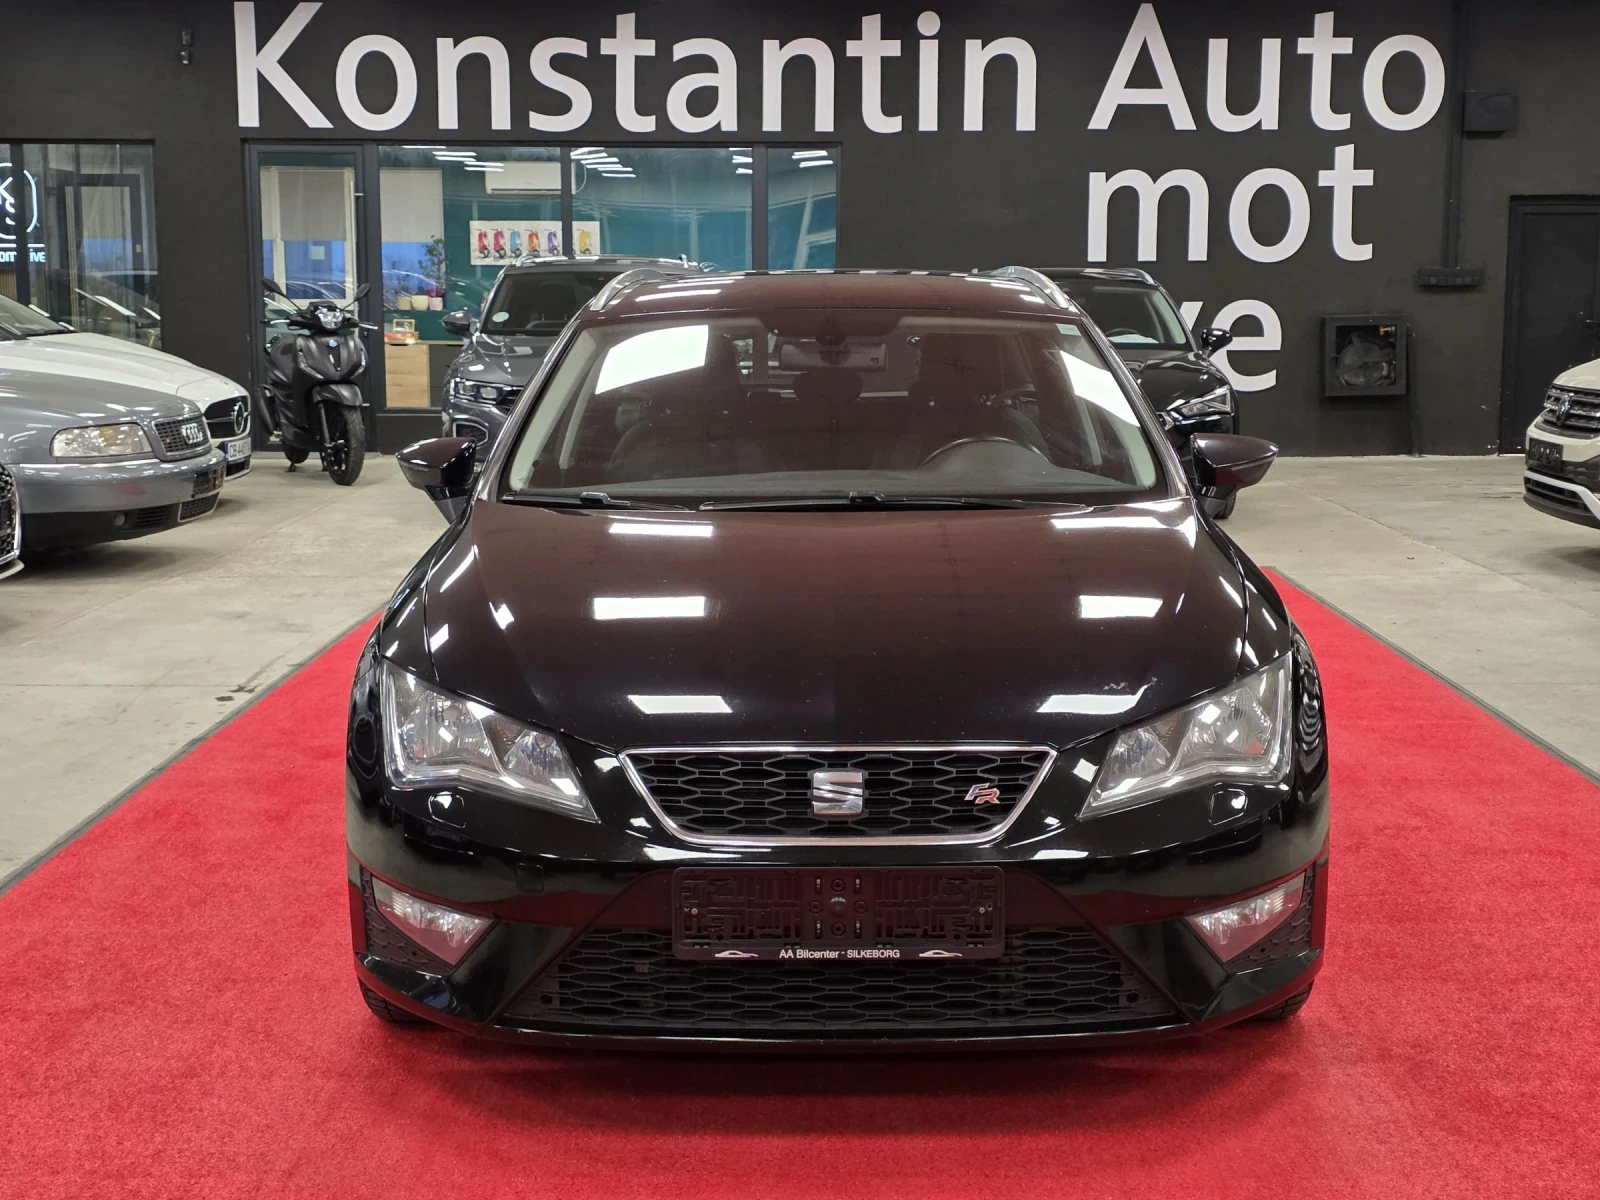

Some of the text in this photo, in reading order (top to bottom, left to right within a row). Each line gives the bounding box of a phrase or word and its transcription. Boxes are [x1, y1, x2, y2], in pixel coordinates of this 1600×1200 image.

[234, 1, 1445, 132] Konstantin Auto
[1087, 144, 1374, 262] mot
[964, 782, 1001, 805] FR
[779, 949, 794, 959] AA
[796, 949, 840, 959] Bilcenter
[847, 949, 900, 959] SILKEBORG
